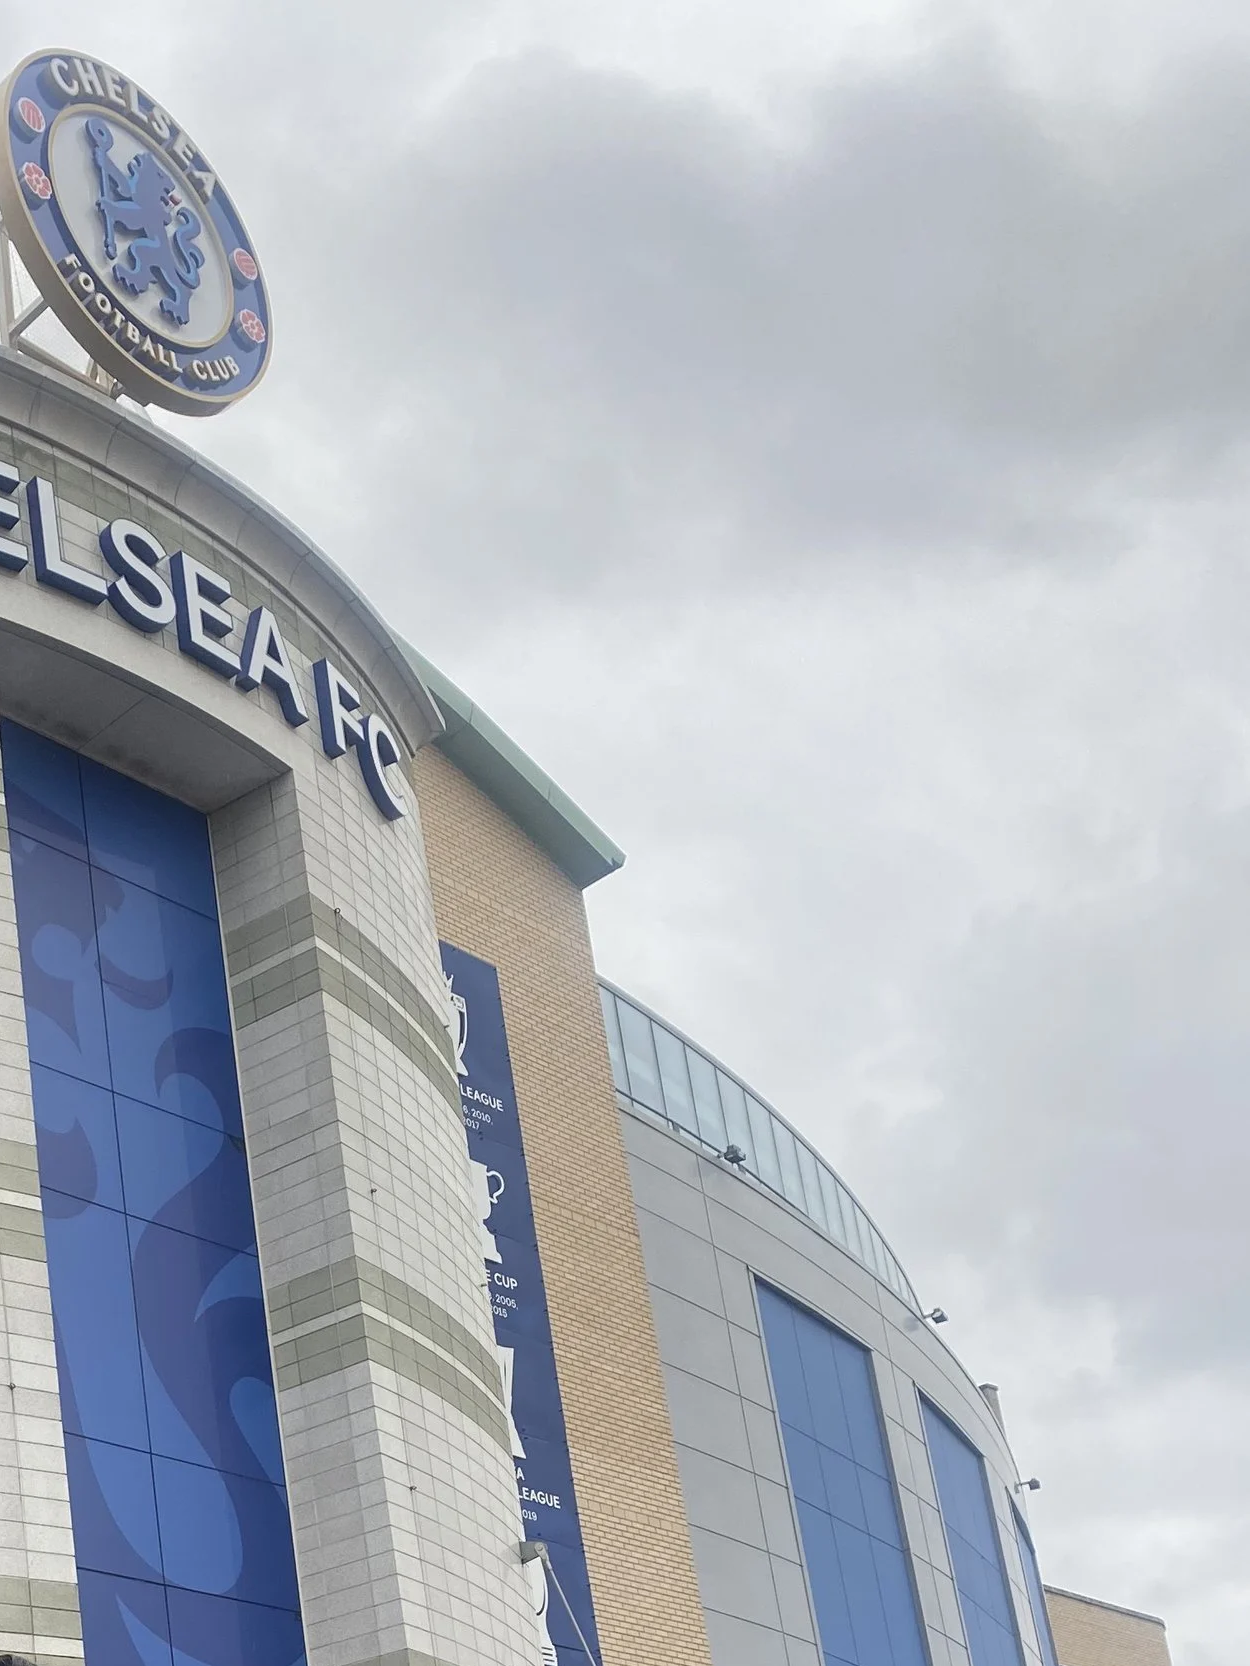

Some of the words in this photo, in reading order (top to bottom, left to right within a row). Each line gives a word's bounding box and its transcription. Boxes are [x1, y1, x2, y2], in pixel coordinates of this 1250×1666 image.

[50, 57, 217, 201] CHELSEA
[65, 253, 184, 374] FOOTBALL
[191, 354, 241, 383] CLUB
[313, 658, 411, 822] FC
[459, 1083, 504, 1112] LEAGUE
[493, 1272, 519, 1290] CUP
[491, 1304, 508, 1318] 015
[522, 1509, 538, 1521] 019
